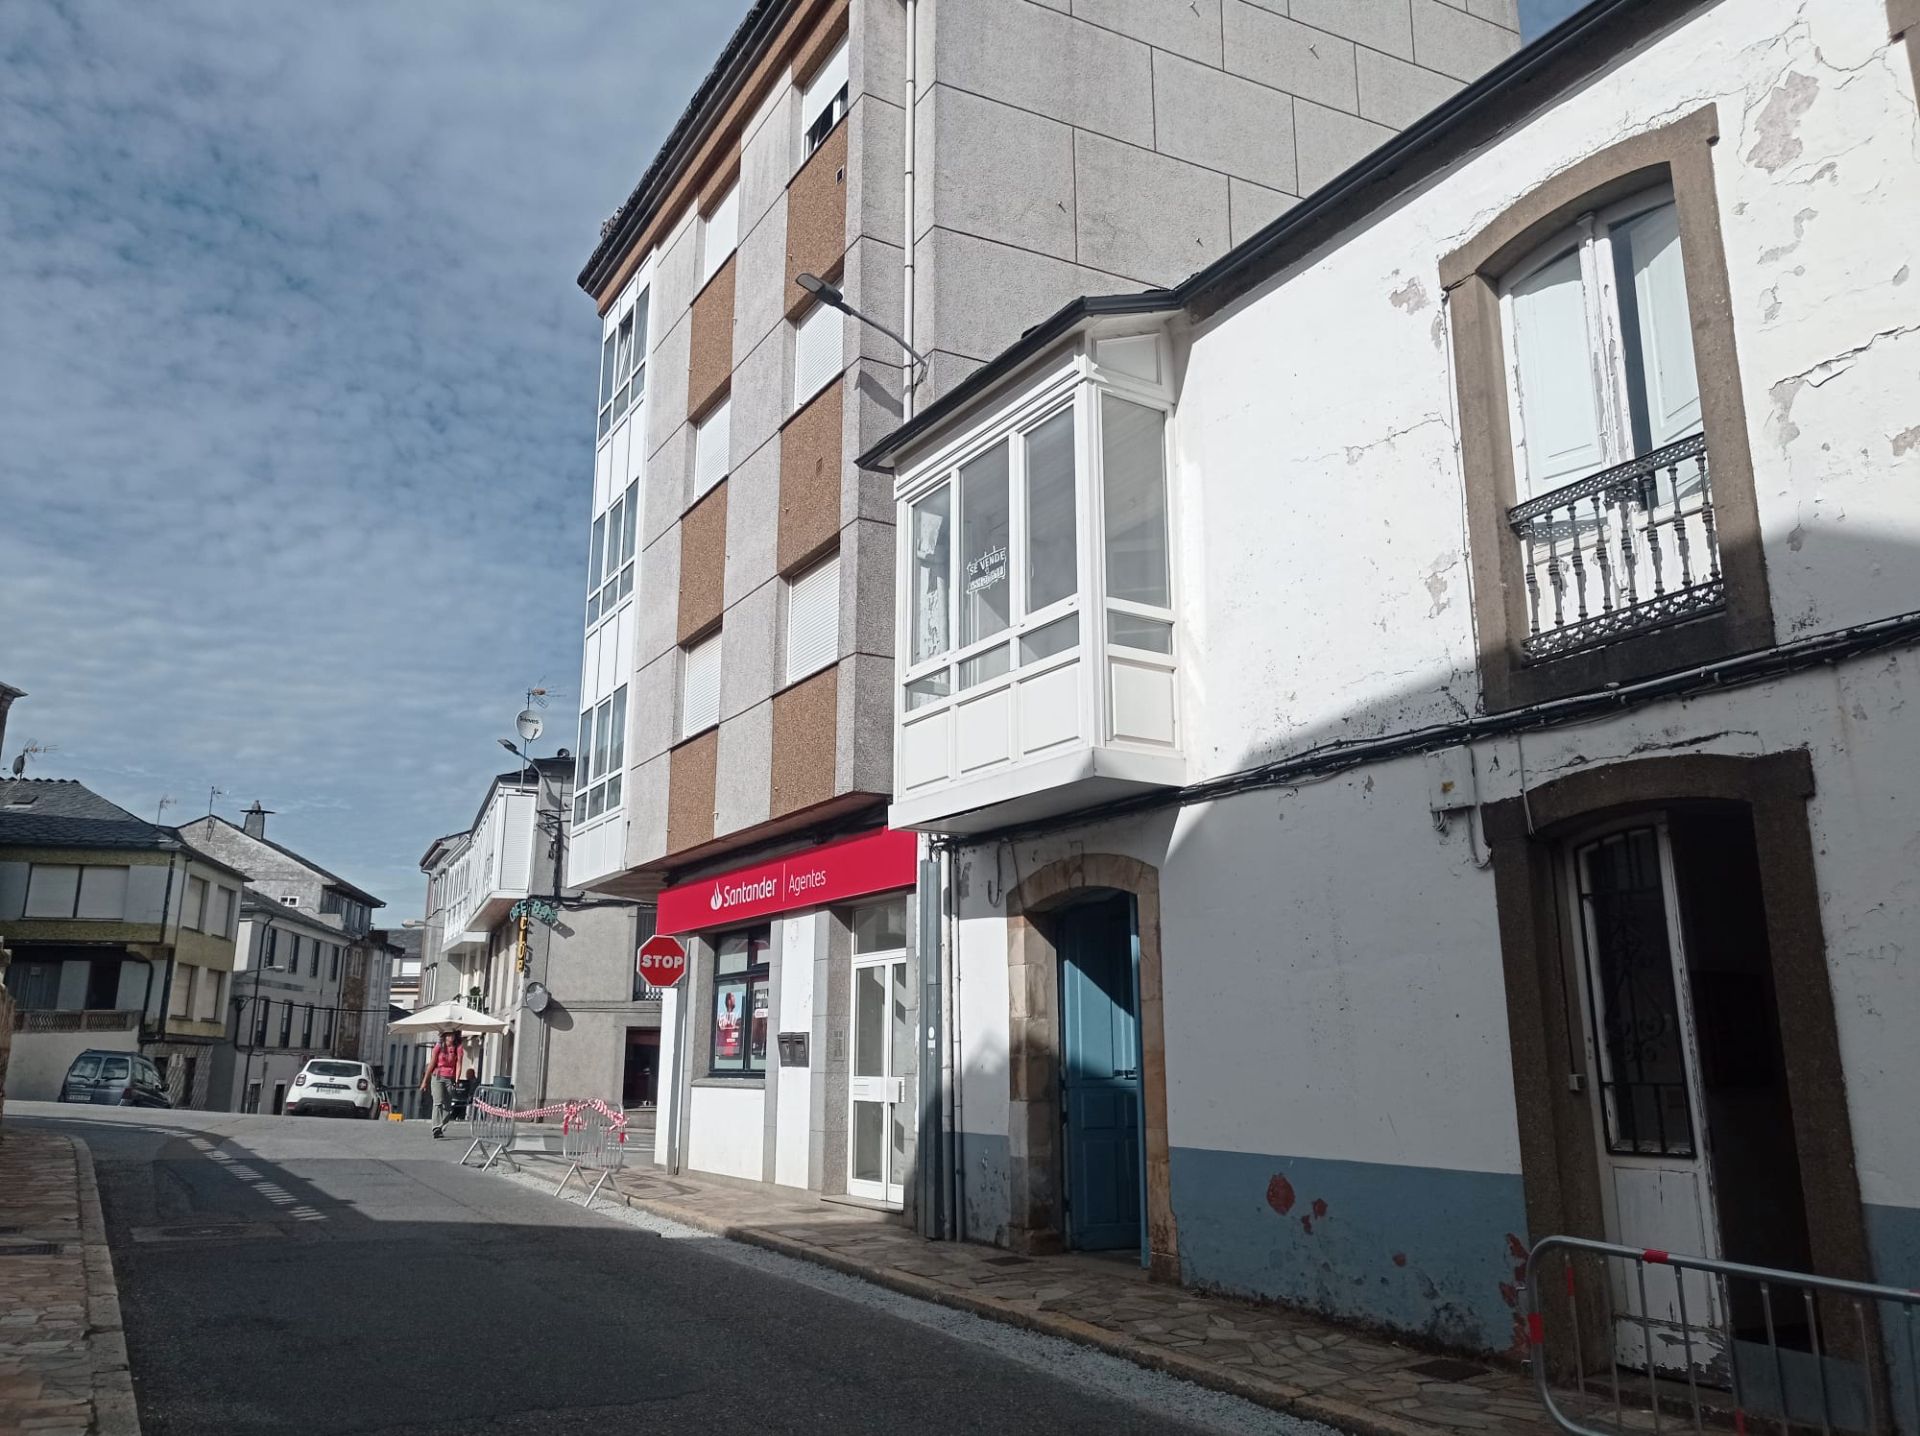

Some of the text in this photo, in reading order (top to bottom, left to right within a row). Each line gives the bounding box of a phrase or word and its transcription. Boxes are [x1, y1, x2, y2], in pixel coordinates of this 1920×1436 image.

[980, 550, 1006, 570] VENDE
[723, 870, 827, 908] Santander Agentes
[641, 954, 684, 969] STOP
